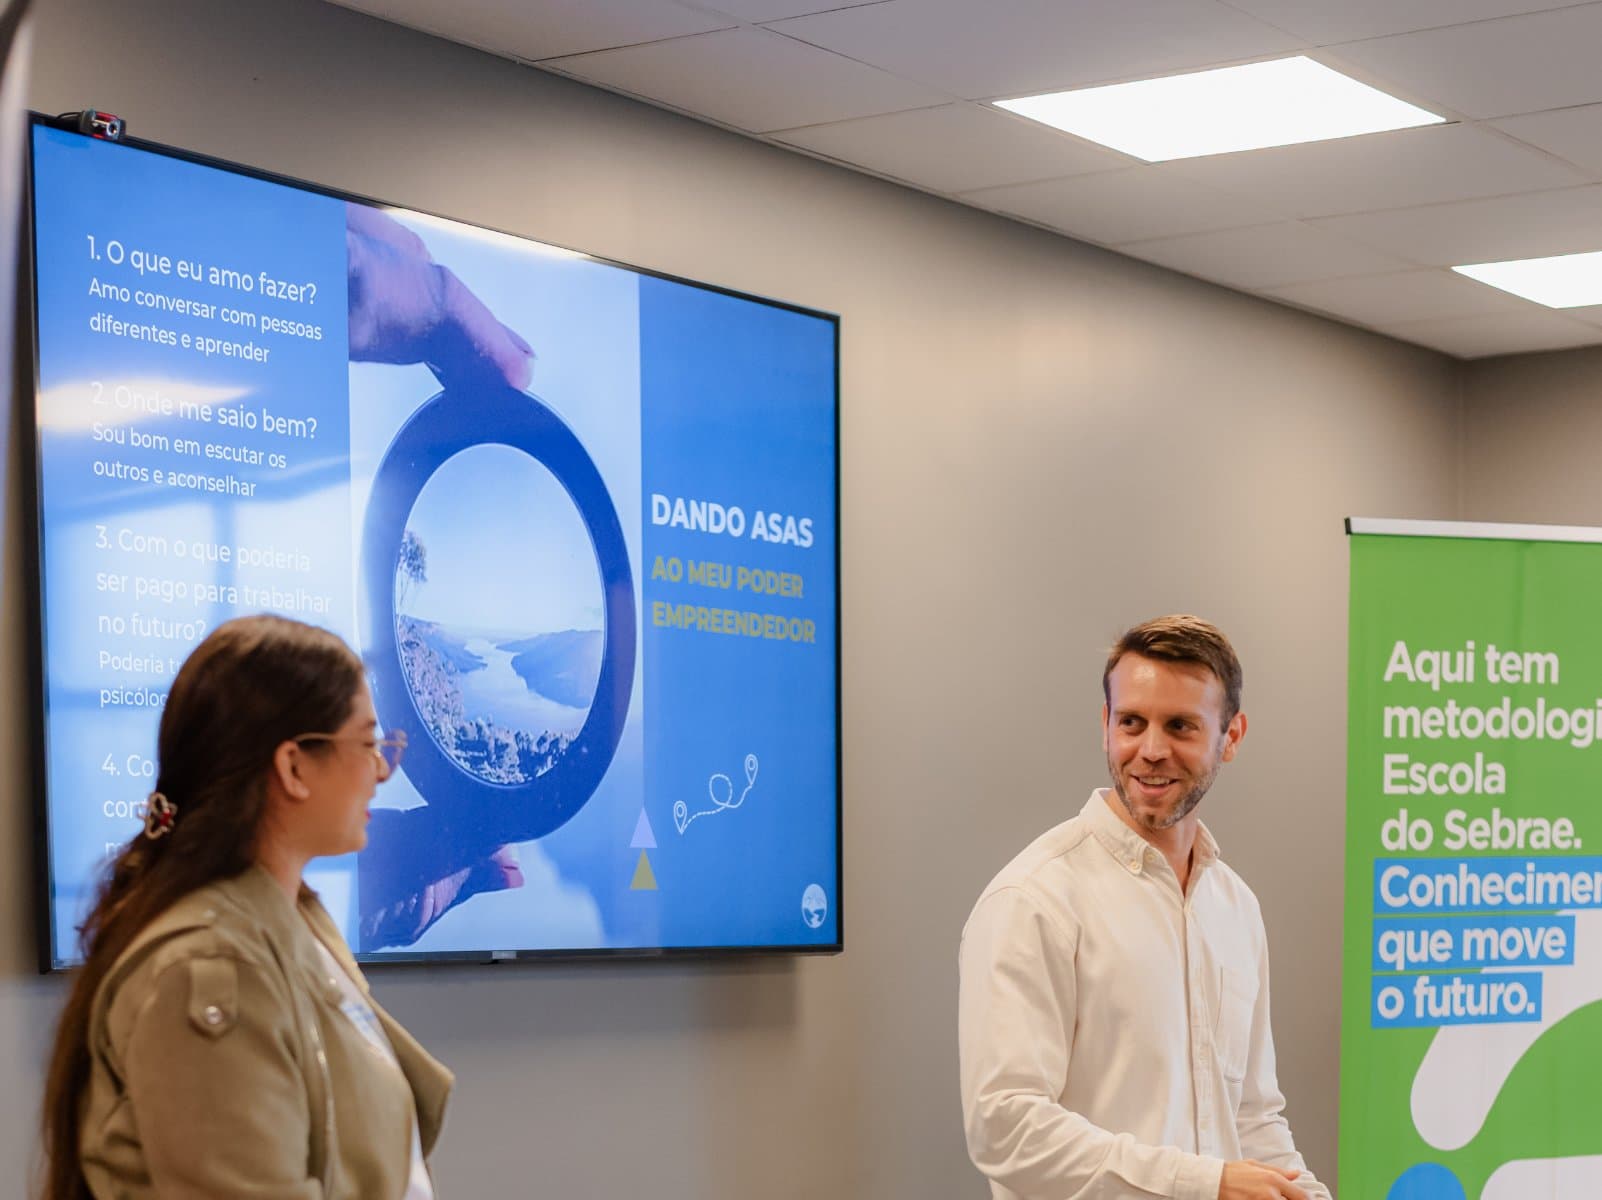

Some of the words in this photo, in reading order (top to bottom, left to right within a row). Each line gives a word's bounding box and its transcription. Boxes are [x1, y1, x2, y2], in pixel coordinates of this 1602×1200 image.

[88, 235, 101, 261] 1.
[107, 240, 124, 264] O
[130, 249, 171, 275] que
[177, 262, 202, 281] eu
[209, 267, 253, 291] amo
[259, 272, 317, 305] fazer?
[89, 278, 130, 301] Amo
[135, 289, 216, 319] conversar
[221, 307, 256, 327] com
[261, 315, 322, 340] pessoas
[90, 314, 177, 346] diferentes
[181, 333, 191, 347] e
[195, 338, 269, 363] aprender
[115, 385, 173, 415] Onde
[180, 401, 212, 422] me
[217, 405, 257, 428] saio
[263, 408, 317, 439] bem?
[93, 423, 125, 446] Sou
[130, 427, 169, 452] bom
[174, 440, 200, 456] em
[205, 442, 265, 467] escutar
[268, 452, 286, 469] os
[94, 459, 148, 483] outros
[153, 469, 164, 484] e
[168, 472, 256, 497] aconselhar
[651, 493, 745, 538] DANDO
[750, 510, 814, 548] ASAS
[95, 524, 113, 552] 3.
[118, 530, 168, 557] Com
[174, 538, 186, 557] o
[192, 541, 231, 565] que
[237, 543, 311, 574] poderia
[96, 571, 128, 594] ser
[135, 577, 187, 603] pago
[194, 585, 238, 606] para
[244, 586, 331, 615] trabalhar
[651, 555, 682, 583] AO
[688, 560, 732, 590] MEU
[737, 567, 804, 599] PODER
[98, 614, 125, 636] no
[131, 613, 206, 641] futuro?
[652, 601, 816, 643] EMPREENDEDOR
[99, 650, 164, 674] Poderia
[1383, 640, 1475, 691] Aqui
[1485, 644, 1559, 685] tem
[101, 753, 121, 777] 4.
[126, 754, 155, 777] Co
[1383, 752, 1506, 795] Escola
[1380, 809, 1433, 851] do
[1443, 807, 1582, 851] Sebrae.
[1378, 928, 1453, 971] que
[1462, 925, 1566, 961] move
[1377, 986, 1405, 1019] o
[1413, 976, 1535, 1018] futuro.
